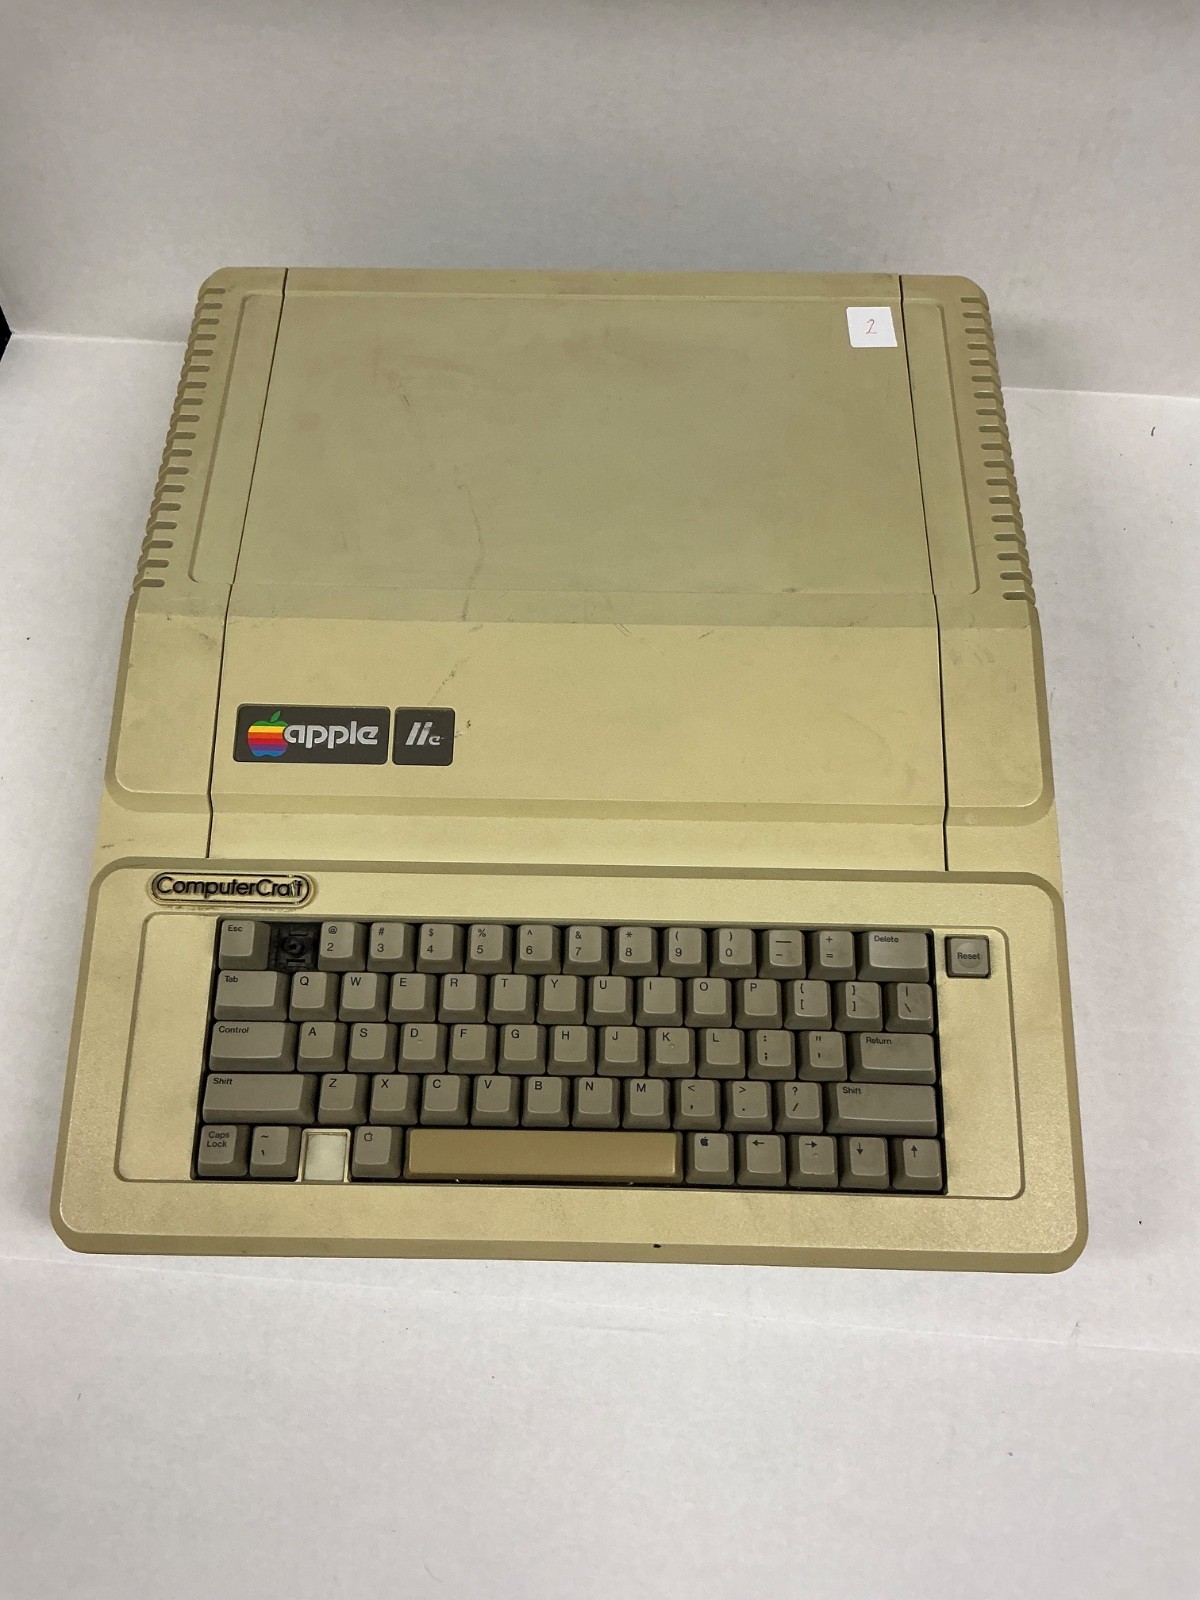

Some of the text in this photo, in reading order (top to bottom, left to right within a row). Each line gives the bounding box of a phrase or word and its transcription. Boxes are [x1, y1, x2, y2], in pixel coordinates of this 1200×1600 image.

[866, 319, 877, 335] 2
[284, 721, 379, 749] apple
[227, 924, 244, 933] Esc
[327, 925, 339, 935] @
[377, 926, 386, 936] #
[427, 927, 436, 938] $
[476, 928, 488, 938] %
[574, 930, 583, 940] &
[873, 934, 900, 944] Delete
[326, 942, 335, 952] 2
[376, 943, 386, 953] 3
[426, 944, 435, 954] 4
[476, 944, 485, 955] 5
[525, 945, 534, 955] 6
[574, 946, 583, 957] 7
[624, 947, 633, 958] 8
[674, 947, 683, 958] 9
[724, 947, 734, 958] 0
[956, 951, 982, 961] Reset
[224, 974, 240, 984] Tab
[299, 975, 310, 986] Q
[349, 976, 363, 987] W
[398, 977, 408, 988] E
[449, 977, 460, 988] R
[500, 978, 509, 989] T
[550, 978, 560, 989] Y
[598, 979, 608, 990] U
[698, 981, 710, 992] O
[749, 982, 759, 993] P
[217, 1025, 250, 1035] Control
[307, 1026, 318, 1037] A
[358, 1027, 369, 1038] S
[409, 1028, 420, 1039] D
[459, 1028, 468, 1039] F
[510, 1028, 521, 1039] G
[560, 1030, 571, 1041] H
[611, 1030, 620, 1042] J
[661, 1031, 671, 1043] K
[711, 1032, 721, 1043] L
[864, 1036, 893, 1046] Return
[212, 1077, 234, 1086] Shift
[328, 1077, 338, 1088] Z
[380, 1078, 390, 1089] X
[431, 1078, 442, 1089] C
[483, 1079, 493, 1090] V
[533, 1080, 543, 1091] B
[584, 1080, 595, 1092] N
[635, 1082, 647, 1094] M
[841, 1085, 863, 1095] Shift
[207, 1130, 231, 1141] Caps
[205, 1140, 228, 1149] Lock
